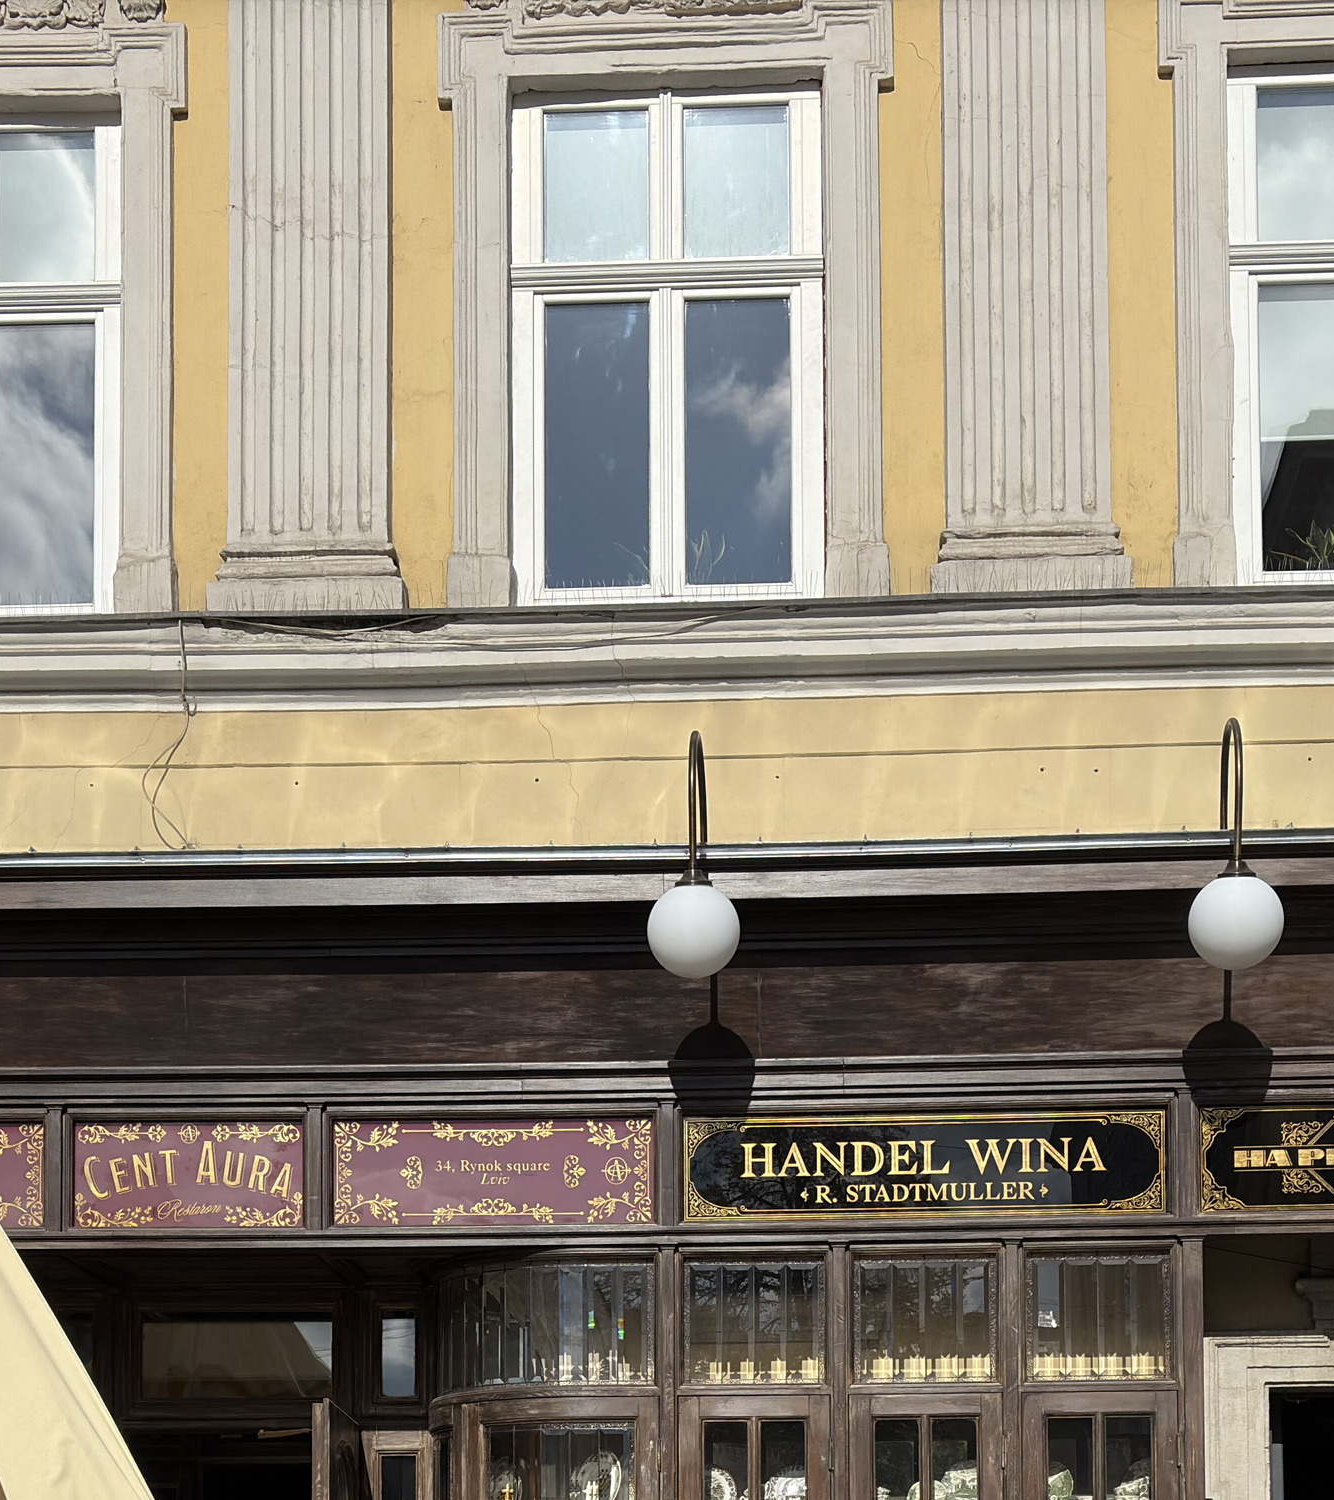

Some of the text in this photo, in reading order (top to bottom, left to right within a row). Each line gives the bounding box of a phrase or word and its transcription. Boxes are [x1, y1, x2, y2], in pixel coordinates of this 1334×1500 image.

[435, 1159, 551, 1175] 34, Rynok square
[740, 1136, 1108, 1179] HANDEL WINA
[1233, 1148, 1293, 1169] НА
[83, 1140, 294, 1202] CENT AURA
[480, 1173, 511, 1186] Lviv
[815, 1181, 1035, 1204] R. STADTMULLER
